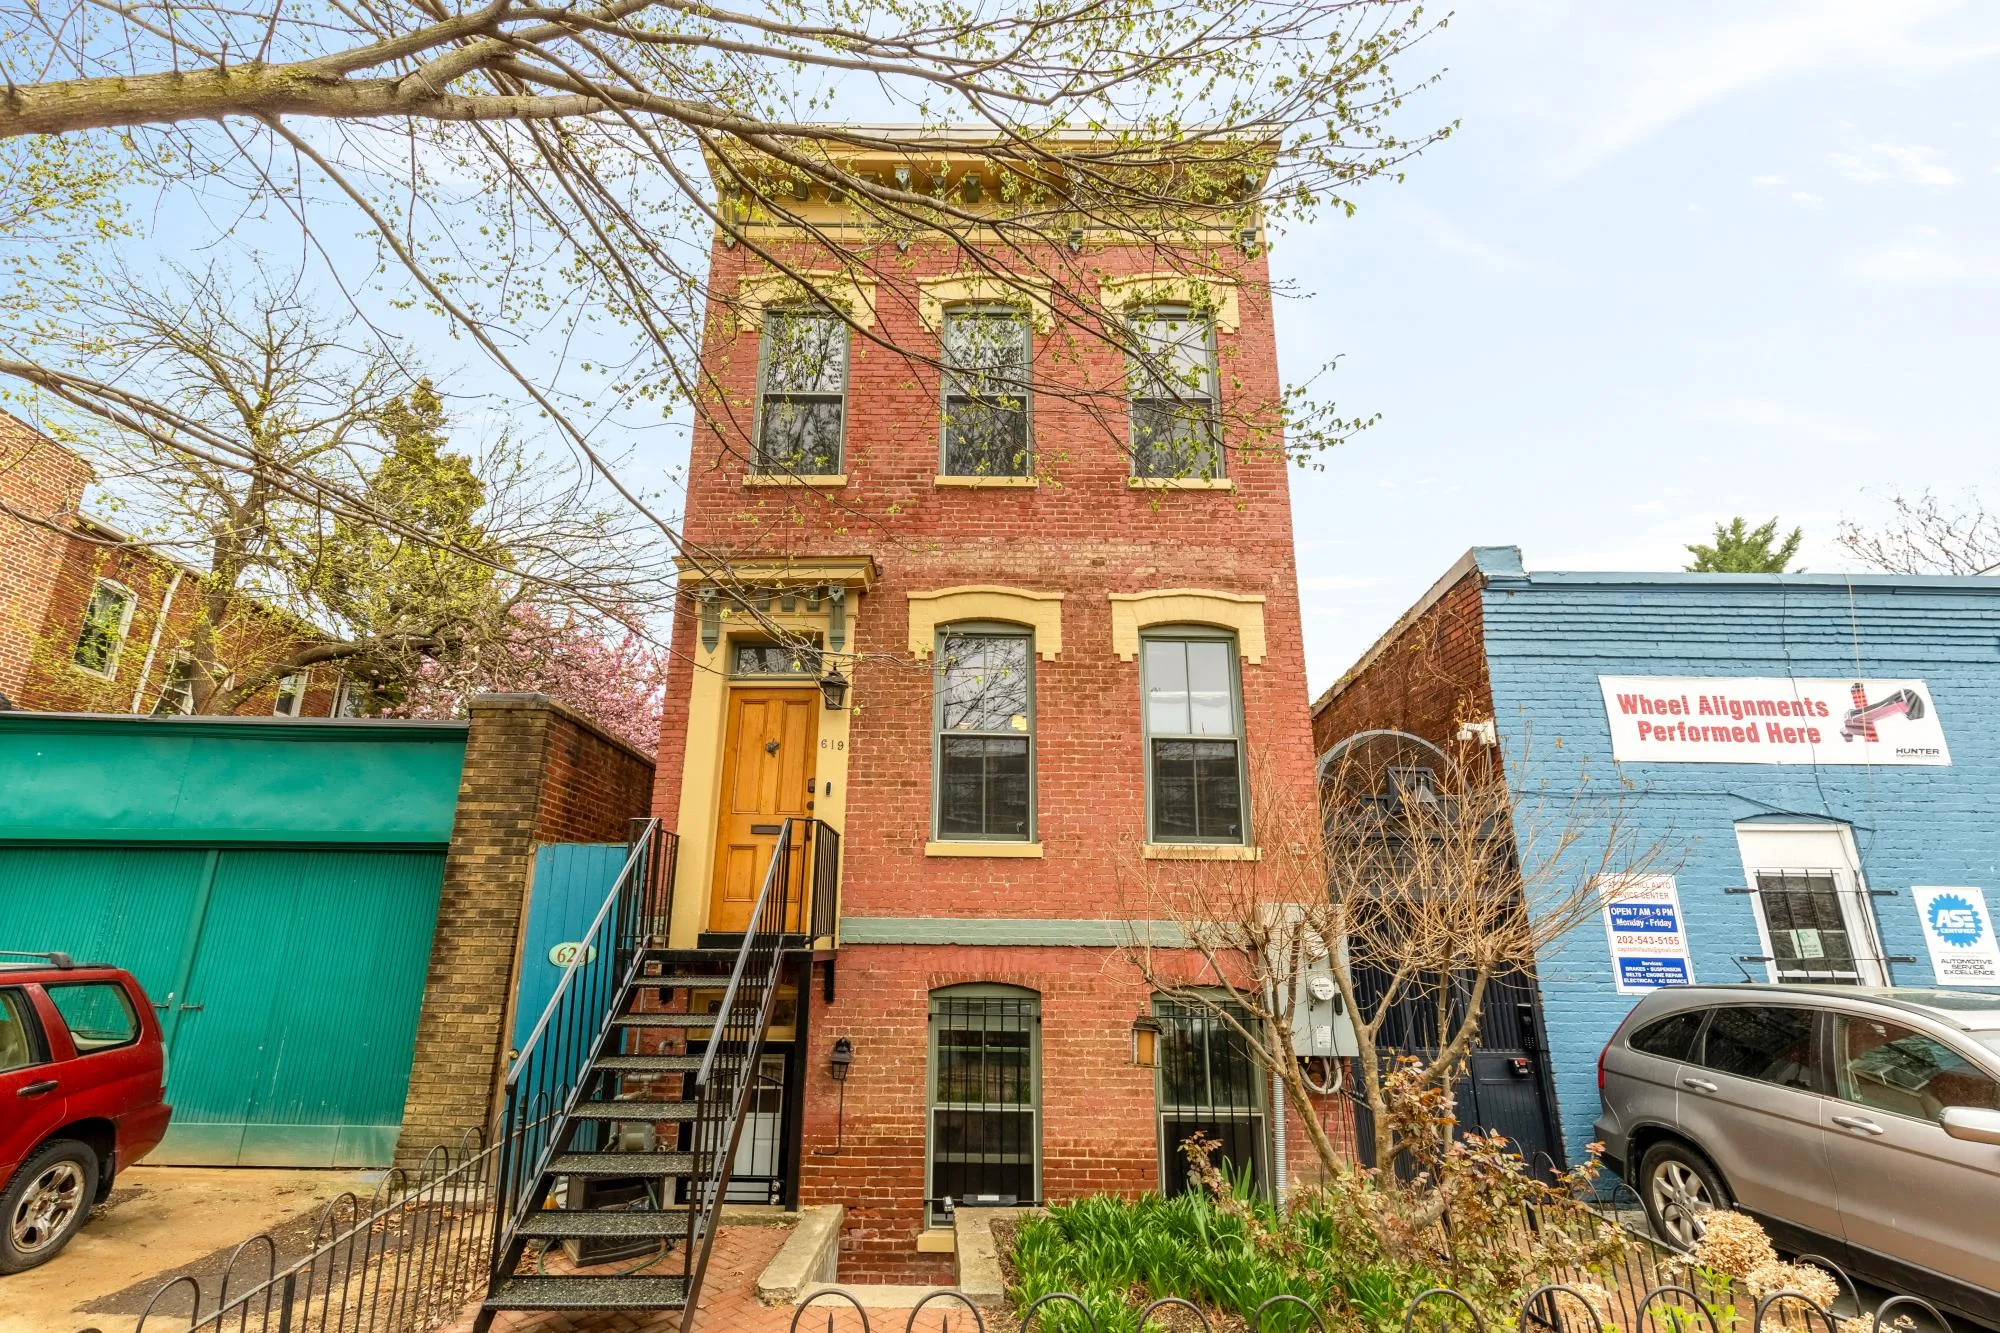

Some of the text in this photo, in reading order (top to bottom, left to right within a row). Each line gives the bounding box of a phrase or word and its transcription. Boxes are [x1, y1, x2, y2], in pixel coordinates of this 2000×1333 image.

[1616, 693, 1830, 720] Wheel Alignments
[1637, 720, 1821, 744] Performed Here
[820, 739, 844, 751] 619
[1652, 881, 1671, 889] AUTO
[1610, 907, 1632, 916] OPEN
[1639, 908, 1651, 916] AM
[1662, 908, 1674, 916] PM
[1616, 918, 1644, 928] Monday
[1649, 919, 1672, 929] Friday
[1935, 909, 1976, 928] ASE
[1616, 935, 1680, 945] 202-543-5155
